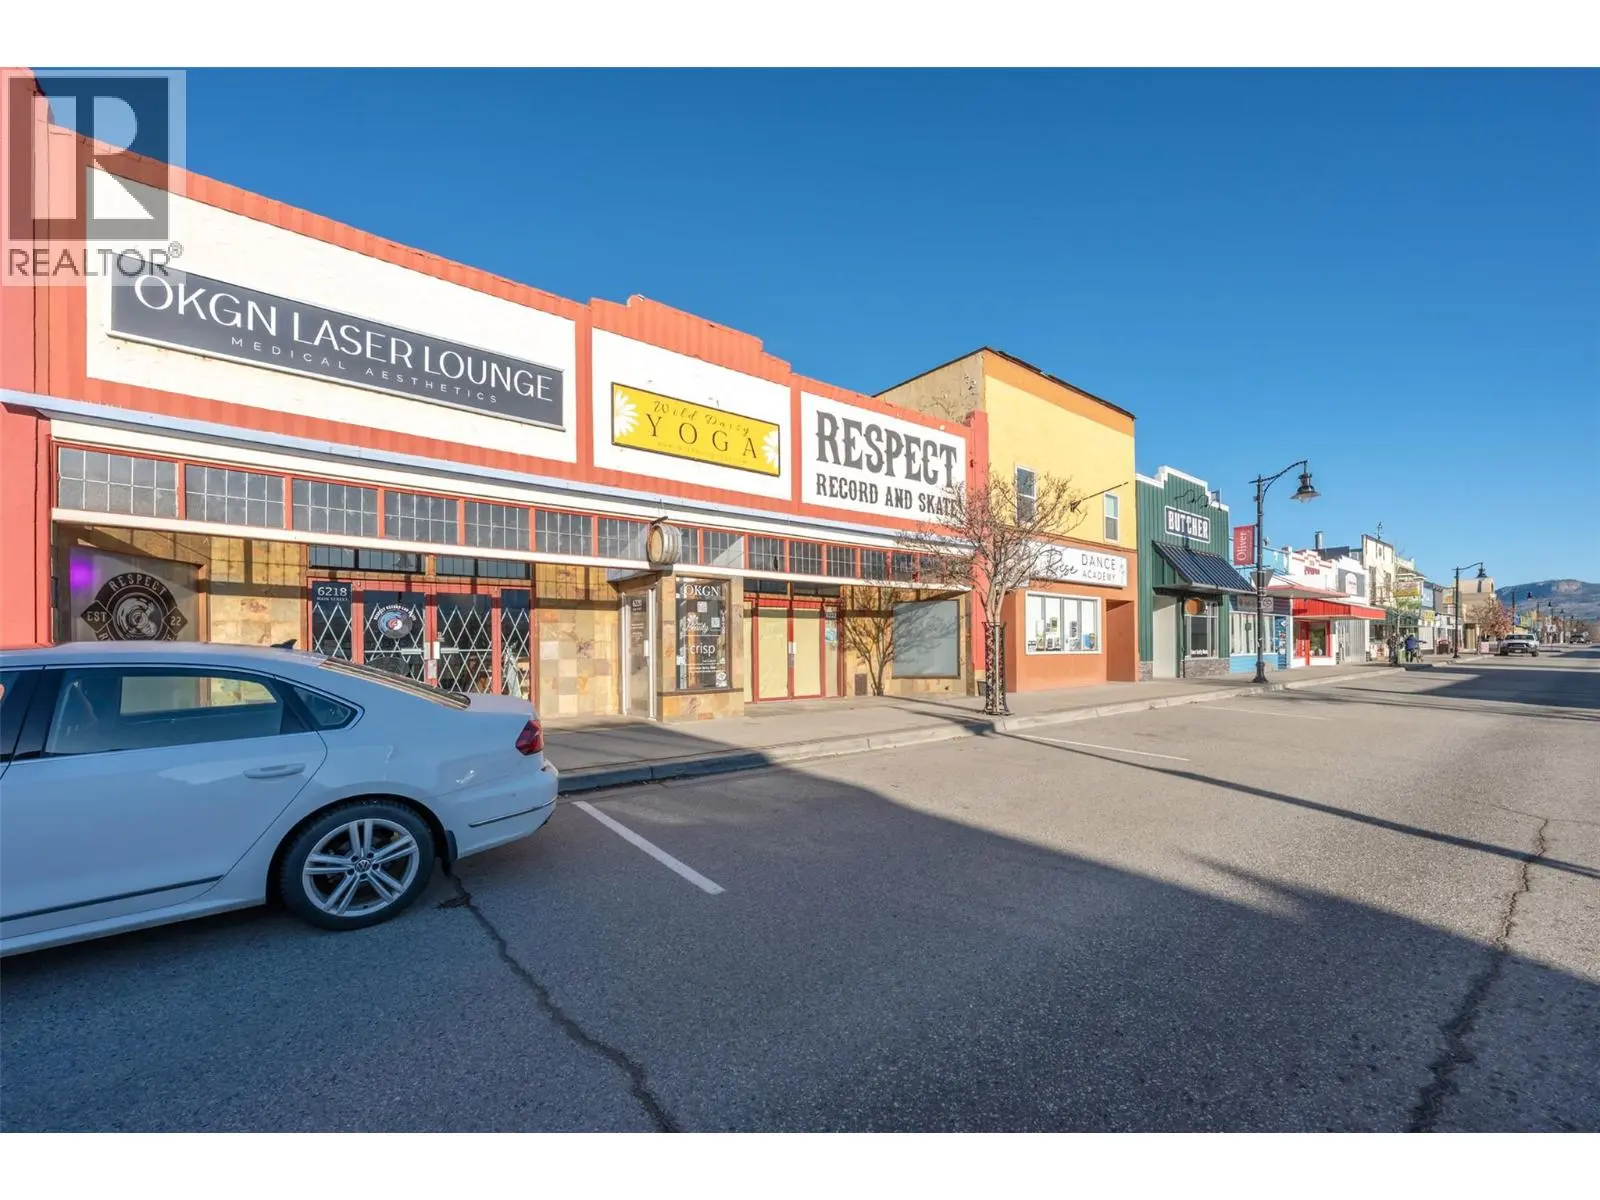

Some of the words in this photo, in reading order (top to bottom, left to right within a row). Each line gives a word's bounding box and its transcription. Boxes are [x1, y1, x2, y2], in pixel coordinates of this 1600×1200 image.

[134, 274, 277, 336] OKGN
[293, 311, 412, 369] LASER
[424, 346, 553, 402] LOUNGE
[231, 336, 346, 370] MEDICAL
[365, 366, 497, 403] AESTHETICS
[646, 413, 758, 459] YOGA
[815, 410, 957, 488] RESPECT
[816, 473, 878, 504] RECORD
[884, 486, 913, 510] AND
[1167, 510, 1209, 539] BUTCHER
[1236, 532, 1248, 561] Oliver
[1081, 553, 1116, 571] DANCE
[108, 574, 167, 594] RESPECT
[1082, 569, 1117, 581] ACADEMY
[317, 586, 348, 597] 6218
[685, 584, 719, 596] OKGN
[87, 611, 107, 622] EST
[170, 616, 181, 626] 22
[689, 642, 715, 656] crisp
